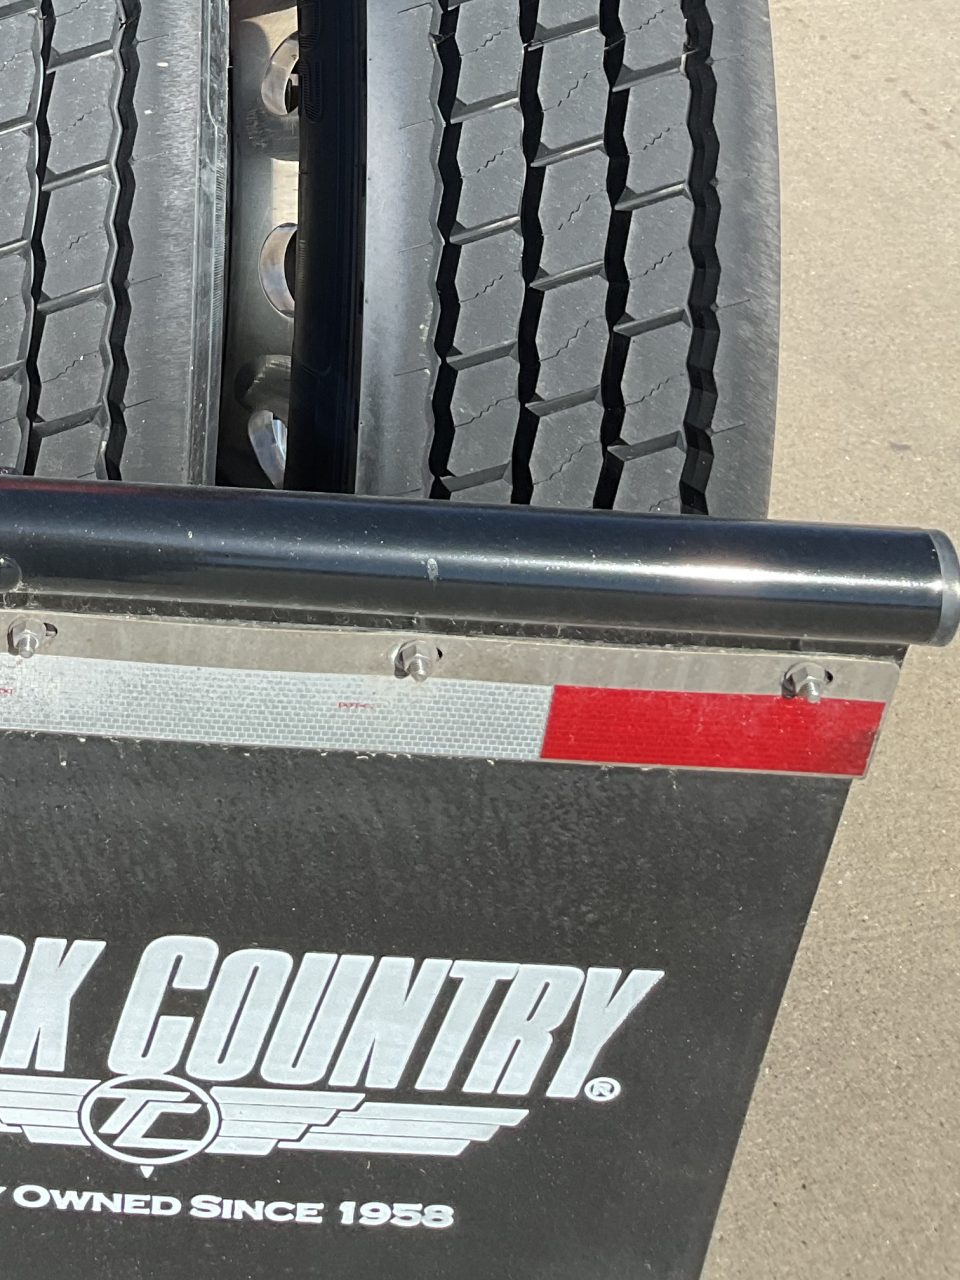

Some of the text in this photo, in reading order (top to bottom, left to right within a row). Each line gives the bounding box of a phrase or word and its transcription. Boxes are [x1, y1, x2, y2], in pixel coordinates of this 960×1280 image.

[12, 1184, 182, 1216] OWNED
[190, 1194, 325, 1224] SINCE
[339, 1201, 455, 1229] 1958
